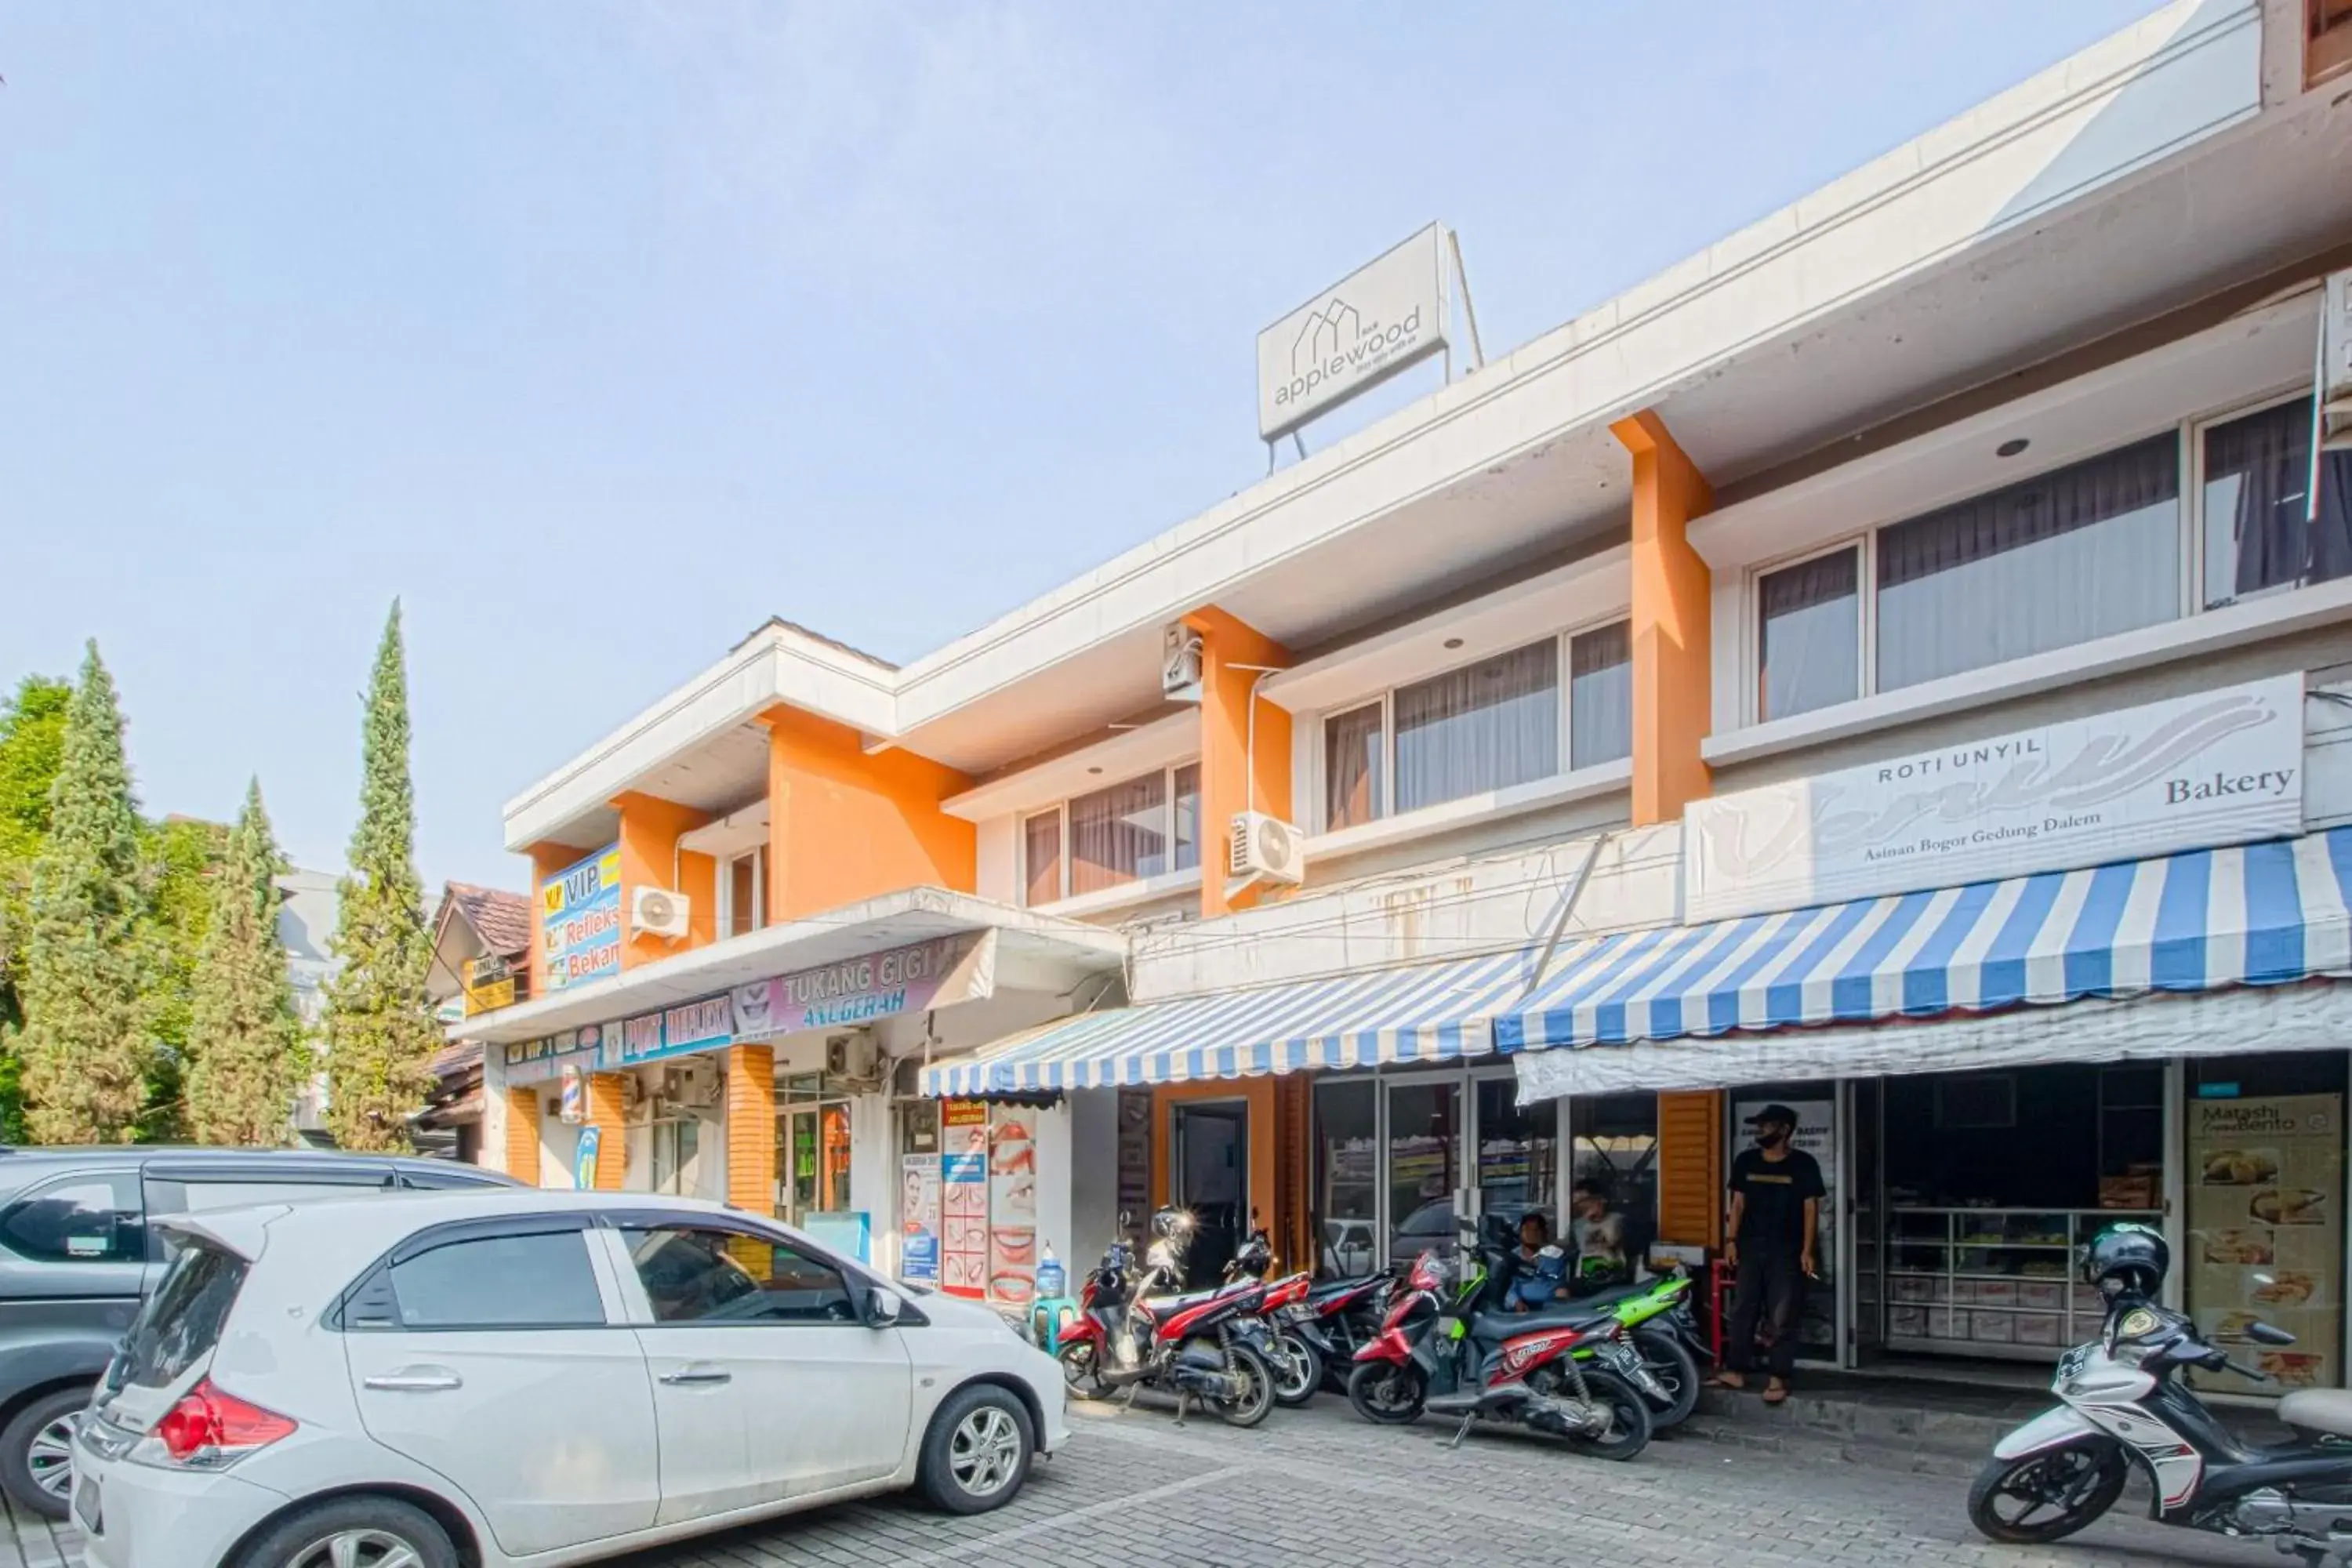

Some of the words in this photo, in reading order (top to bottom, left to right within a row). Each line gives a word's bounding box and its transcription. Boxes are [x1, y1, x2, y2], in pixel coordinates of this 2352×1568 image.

[1275, 304, 1420, 406] applewood
[1878, 757, 1941, 783] ROTI
[1953, 739, 2041, 768] UNYIL
[2165, 768, 2296, 805] Bakery
[1864, 844, 1915, 862] Asinan
[1920, 835, 1967, 853] Bogor
[1972, 822, 2038, 843] Gedung
[2043, 812, 2102, 832] Dalem
[566, 866, 598, 902] VIP
[784, 960, 874, 1006] TUKANG
[880, 945, 930, 985] GIGI
